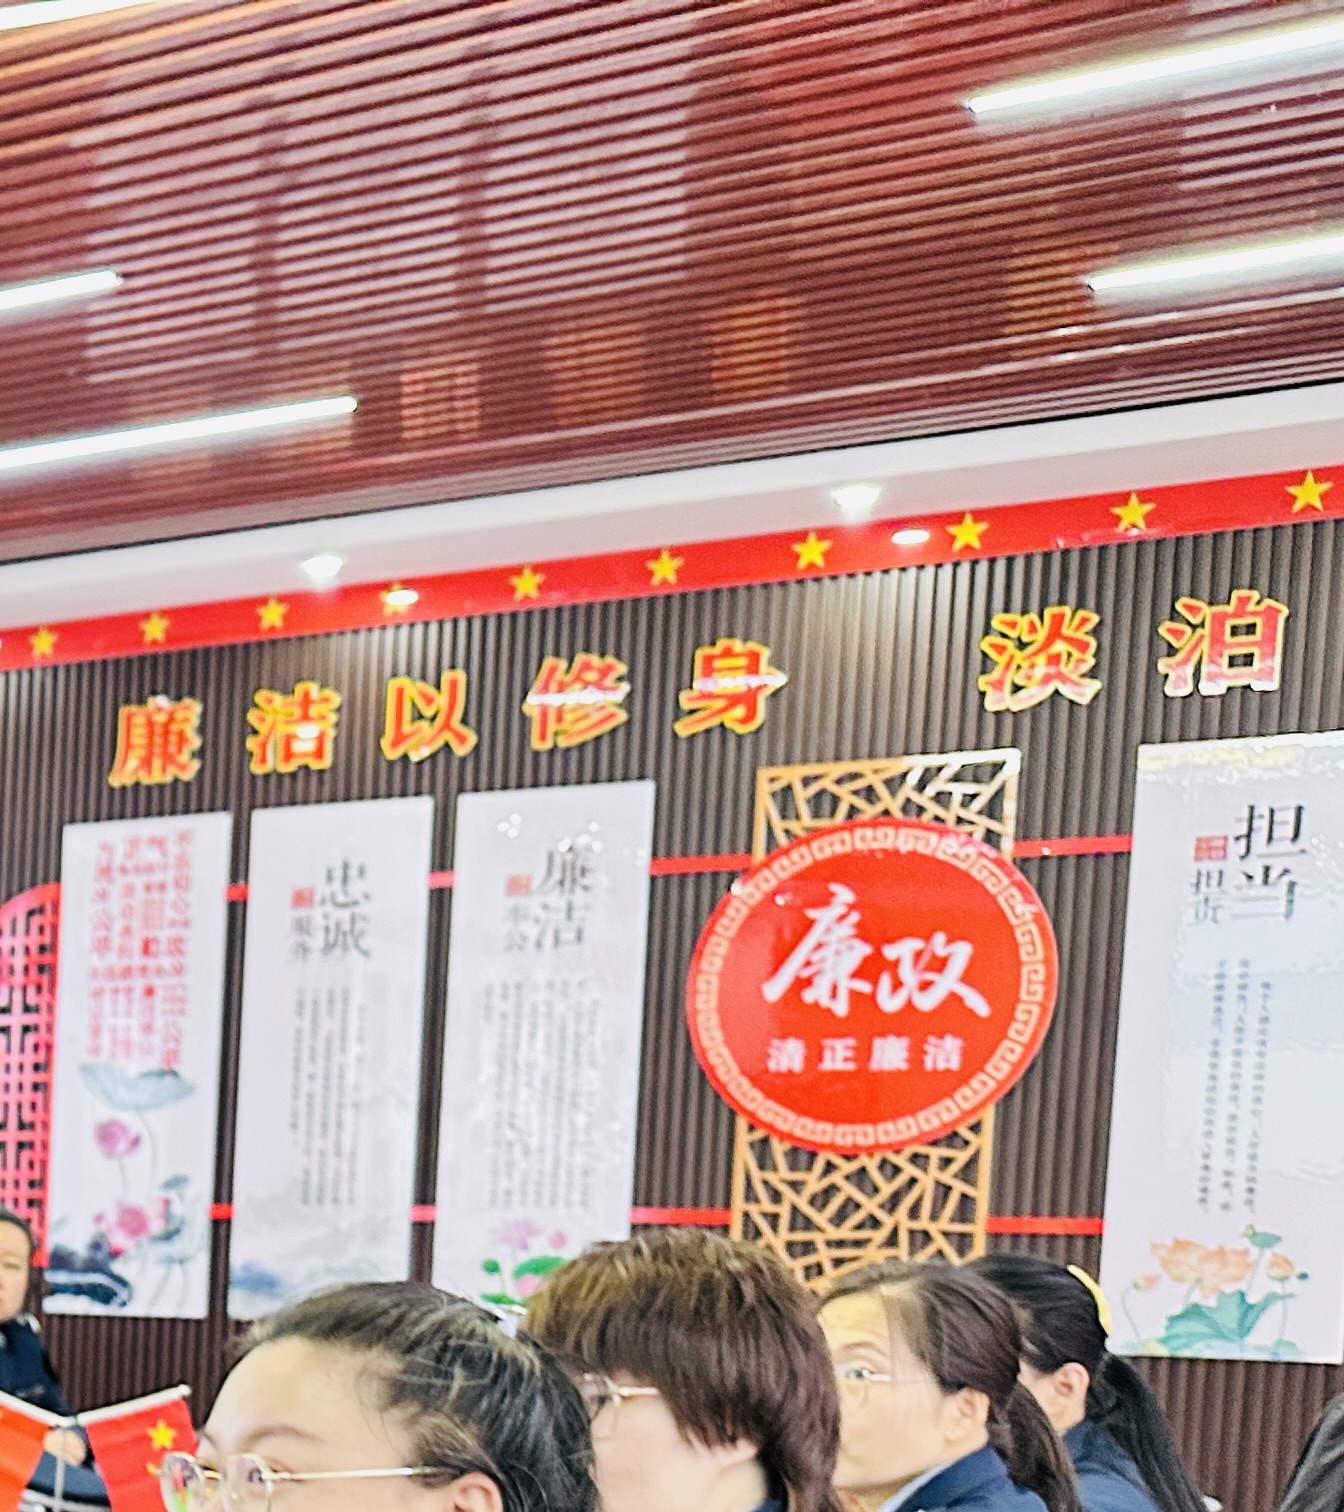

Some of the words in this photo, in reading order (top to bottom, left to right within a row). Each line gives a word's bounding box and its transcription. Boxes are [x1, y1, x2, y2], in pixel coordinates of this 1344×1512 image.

[109, 638, 788, 789] 廉洁以修身
[978, 589, 1290, 713] 淡泊
[319, 856, 372, 960] 忠诚
[533, 842, 596, 951] 廉洁
[1231, 803, 1309, 922] 担当
[762, 882, 992, 1018] 廉政
[766, 1033, 963, 1074] 清正廉洁
